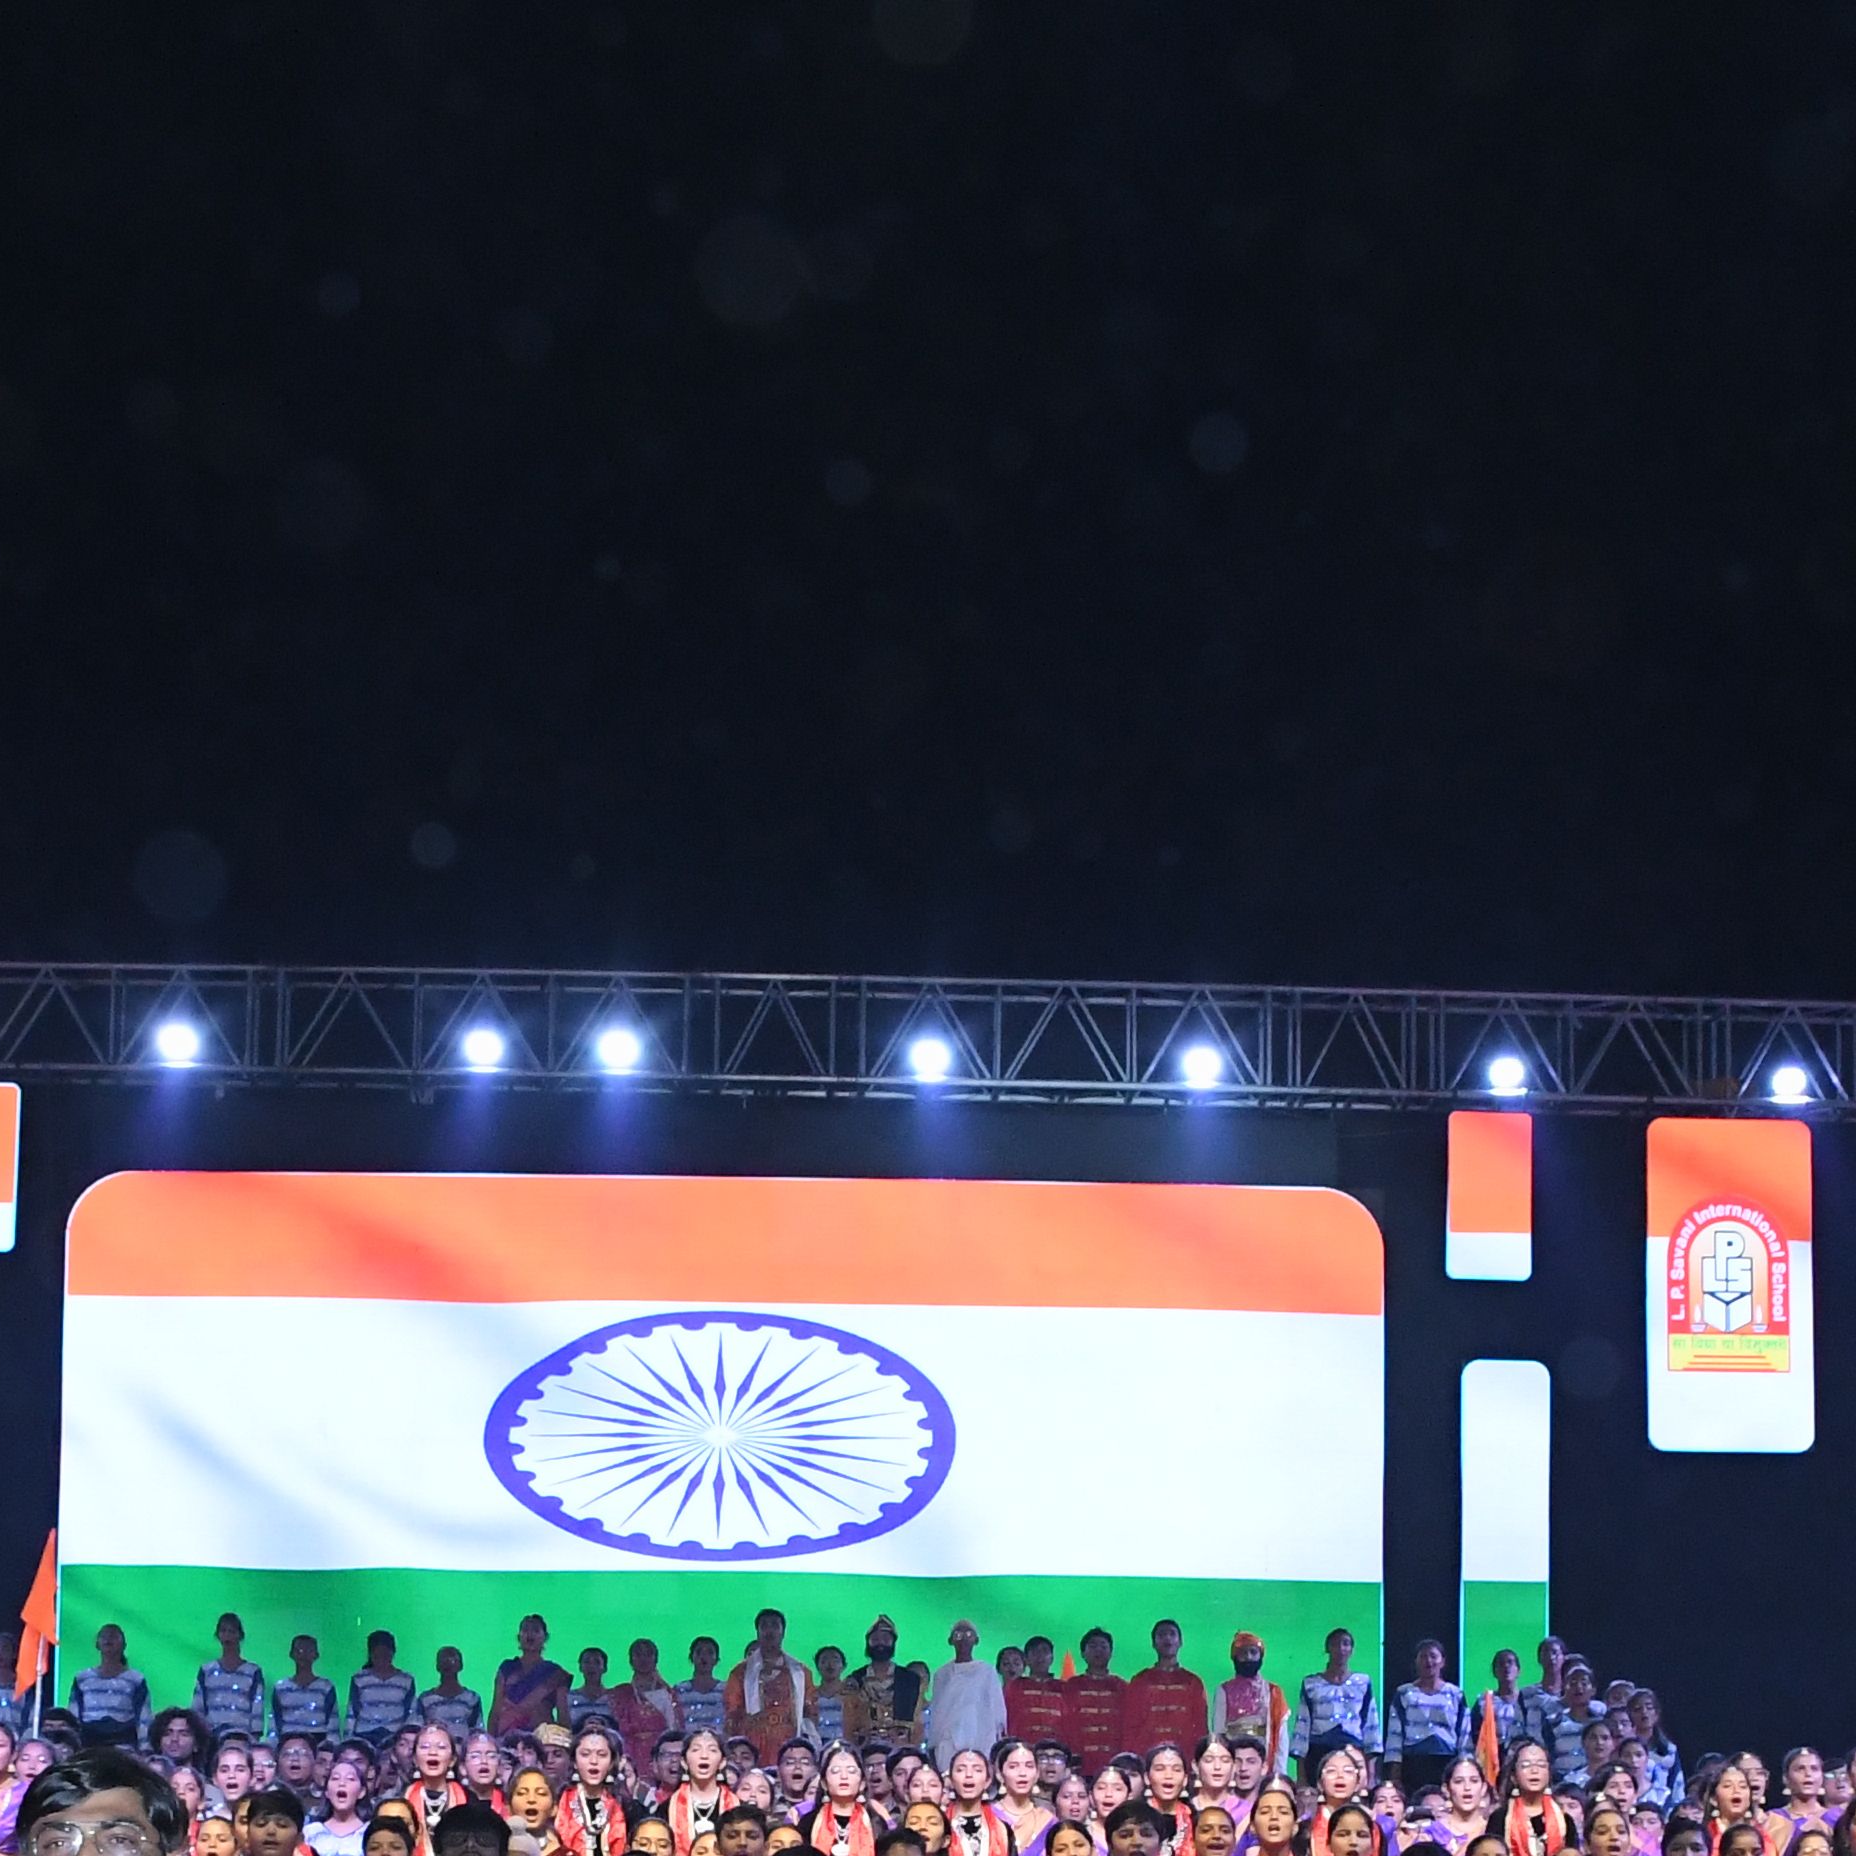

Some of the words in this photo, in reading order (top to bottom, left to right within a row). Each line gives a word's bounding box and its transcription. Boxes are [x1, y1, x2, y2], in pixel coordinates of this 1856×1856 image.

[1670, 1219, 1696, 1280] Savani
[1693, 1204, 1785, 1258] International
[1772, 1262, 1786, 1322] School
